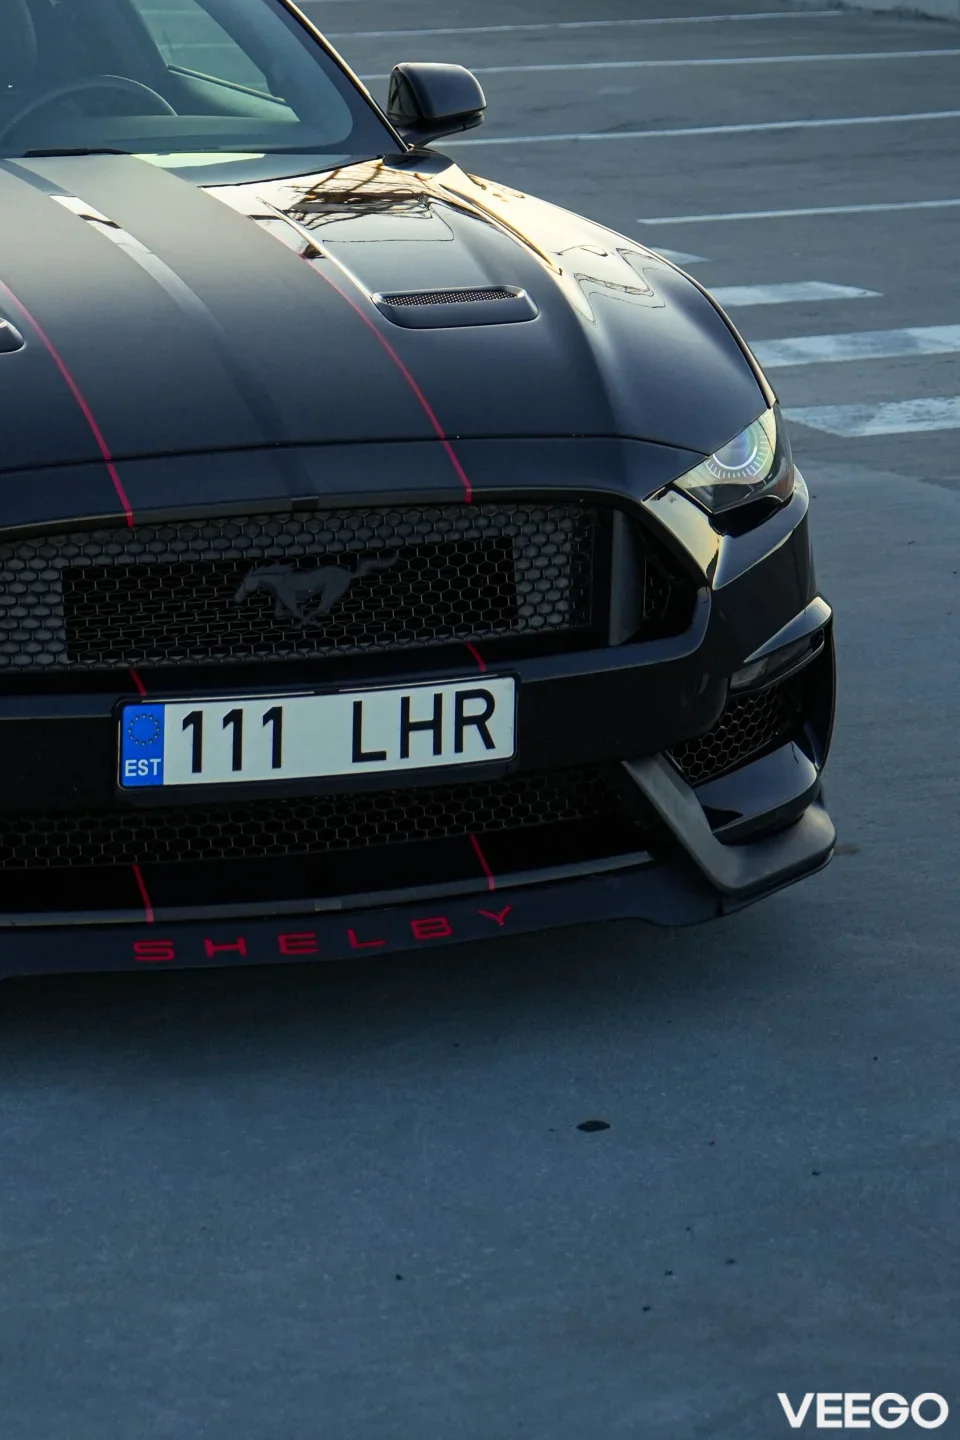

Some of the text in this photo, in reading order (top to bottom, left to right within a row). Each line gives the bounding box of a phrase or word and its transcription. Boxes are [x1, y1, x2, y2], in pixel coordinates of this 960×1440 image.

[182, 688, 496, 773] 111 LHR
[124, 758, 162, 777] EST
[133, 905, 512, 961] SHELBY
